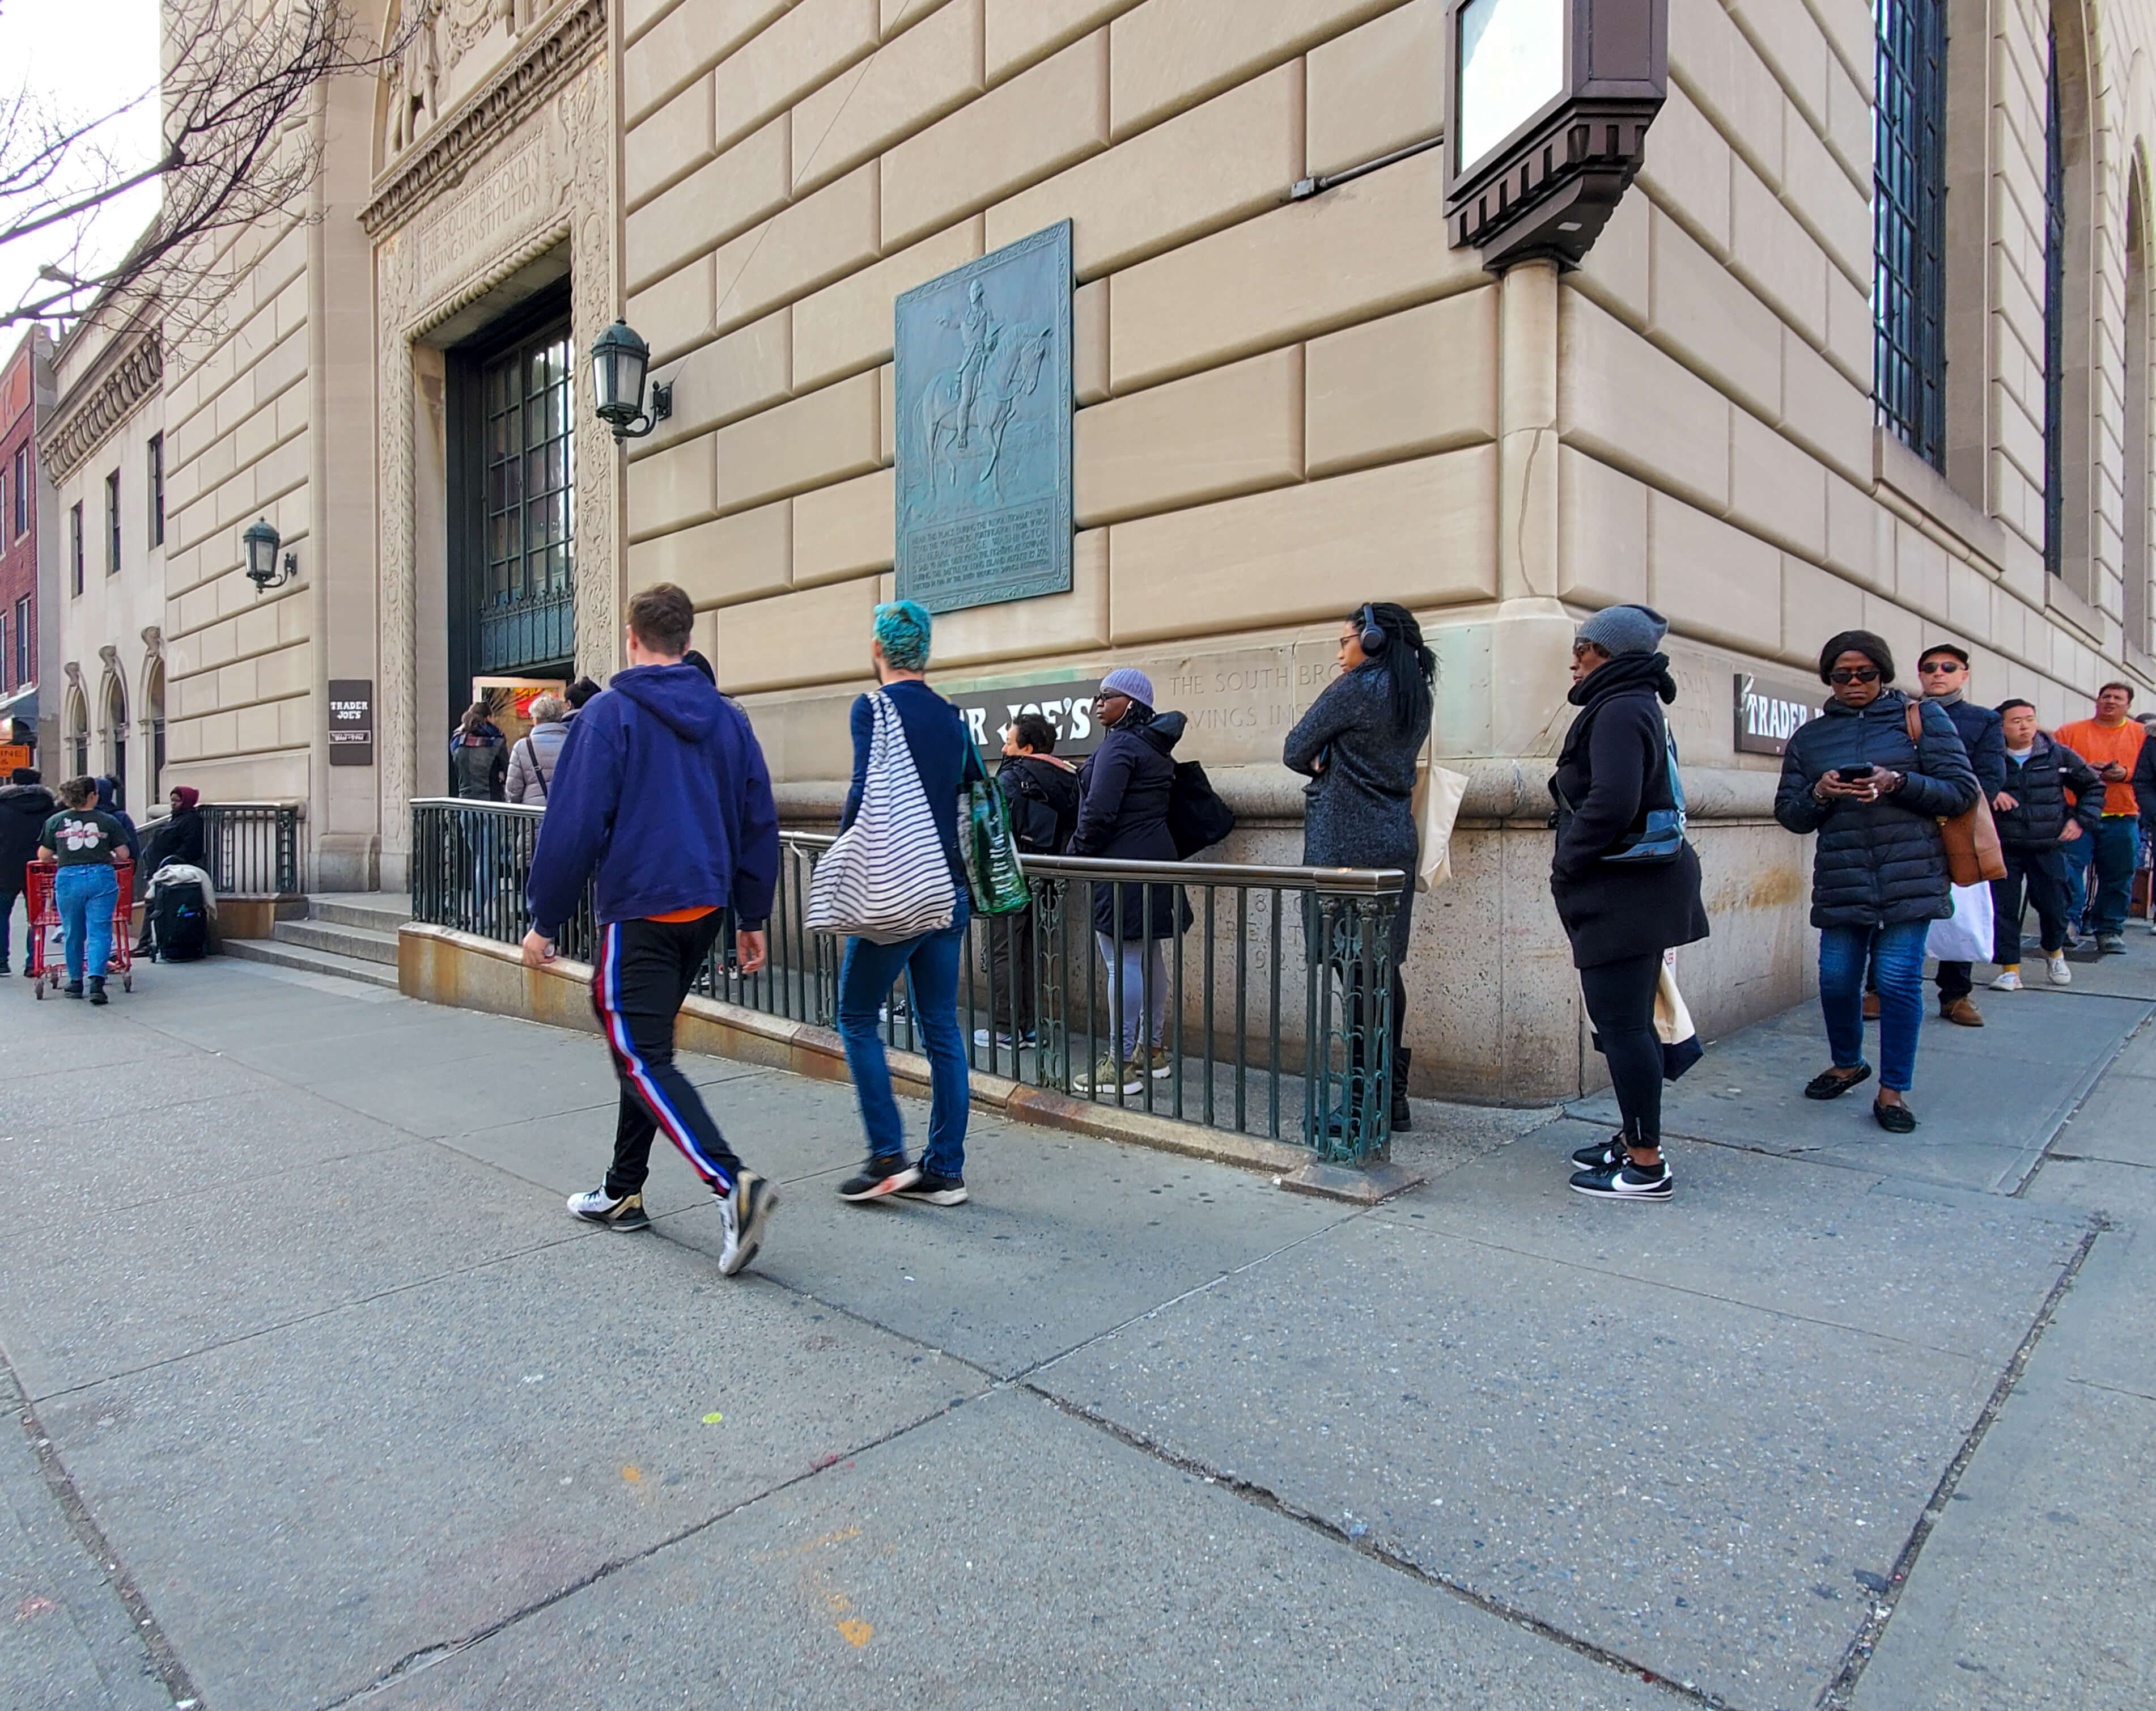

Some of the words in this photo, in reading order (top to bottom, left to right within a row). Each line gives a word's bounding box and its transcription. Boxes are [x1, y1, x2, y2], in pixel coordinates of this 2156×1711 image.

[422, 227, 440, 259] THE
[444, 197, 477, 242] SOUTH
[480, 145, 540, 214] BROOKLYN
[423, 234, 464, 282] SAVINGS
[468, 172, 540, 250] INSTITUTION
[1170, 675, 1205, 696] THE
[1215, 667, 1289, 693] SOUTH
[330, 701, 368, 710] TRADER
[337, 710, 362, 719] JOE'S
